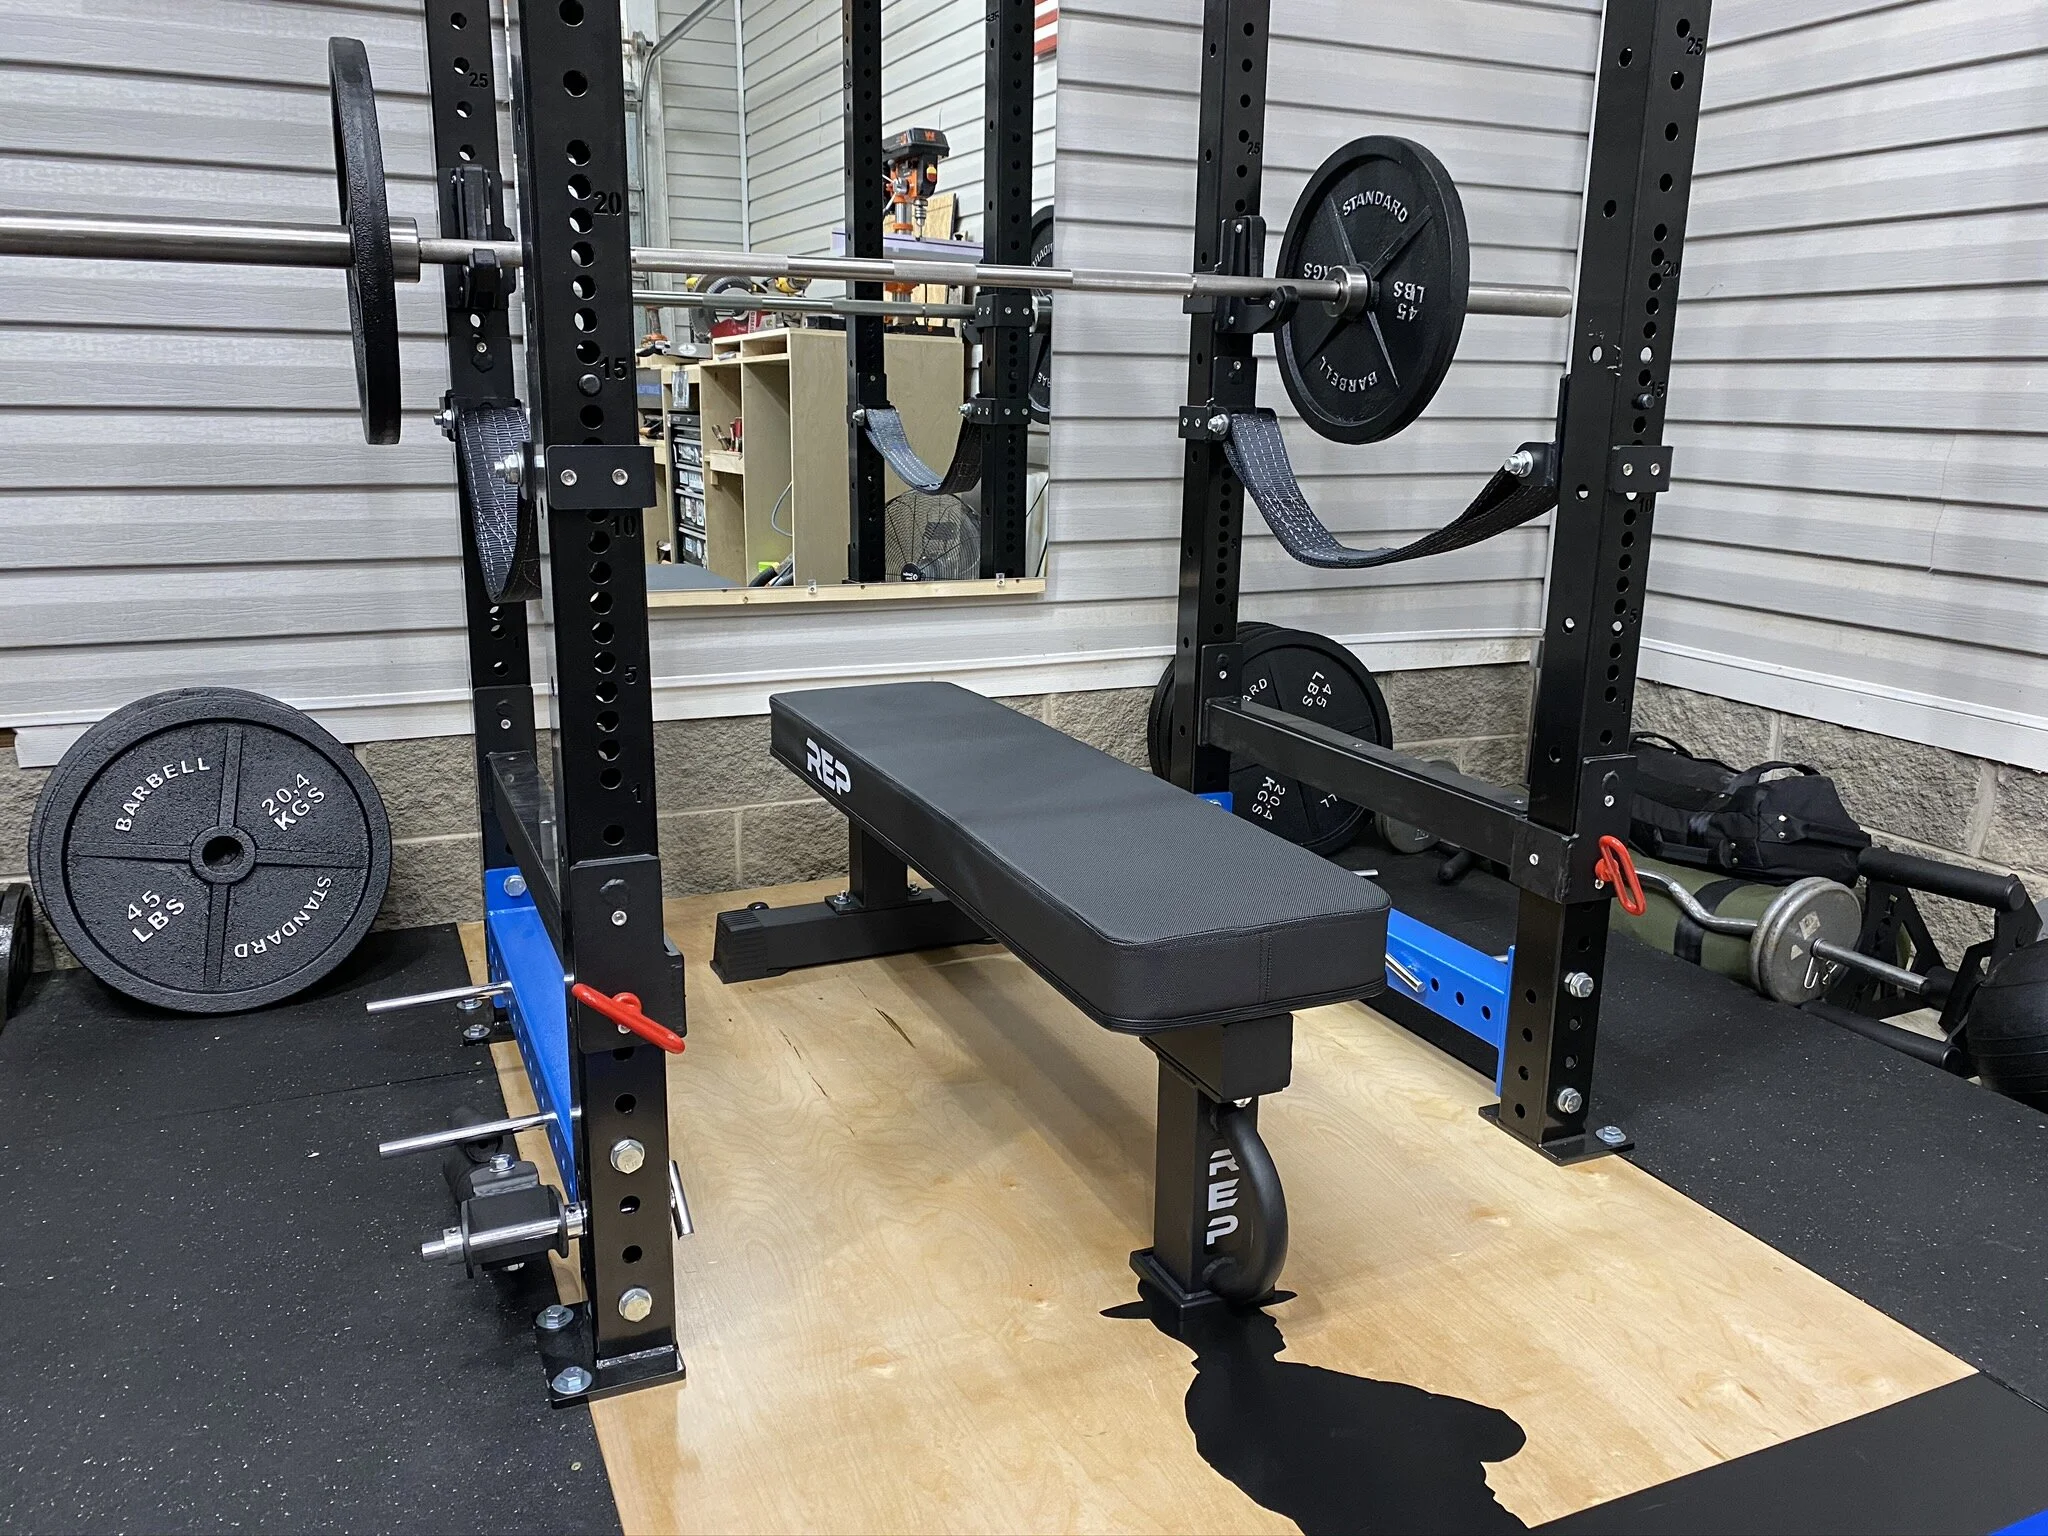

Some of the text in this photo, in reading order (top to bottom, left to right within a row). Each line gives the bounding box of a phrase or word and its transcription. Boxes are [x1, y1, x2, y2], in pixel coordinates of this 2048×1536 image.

[1686, 37, 1704, 56] 25
[468, 72, 489, 88] 25
[1247, 142, 1261, 155] 25
[593, 191, 622, 217] 20
[1342, 190, 1408, 223] STANDARD
[1662, 261, 1680, 279] 20
[1393, 281, 1425, 304] LBS
[1396, 303, 1418, 322] 45
[599, 357, 628, 381] 15
[1319, 355, 1378, 393] BARBELL
[1651, 381, 1666, 399] 15
[1638, 498, 1653, 513] 10
[610, 515, 637, 538] 10
[1628, 609, 1638, 624] 5
[624, 665, 637, 685] 5
[1302, 671, 1325, 707] LBS
[1315, 683, 1333, 708] 45
[805, 737, 851, 796] REP
[114, 757, 211, 832] BARBELL
[632, 782, 642, 803] 1
[1251, 776, 1276, 815] KGS
[273, 787, 325, 831] KGS
[127, 890, 161, 920] 45
[234, 876, 332, 958] STANDARD
[131, 898, 185, 943] LBS
[1206, 1148, 1240, 1246] REP
